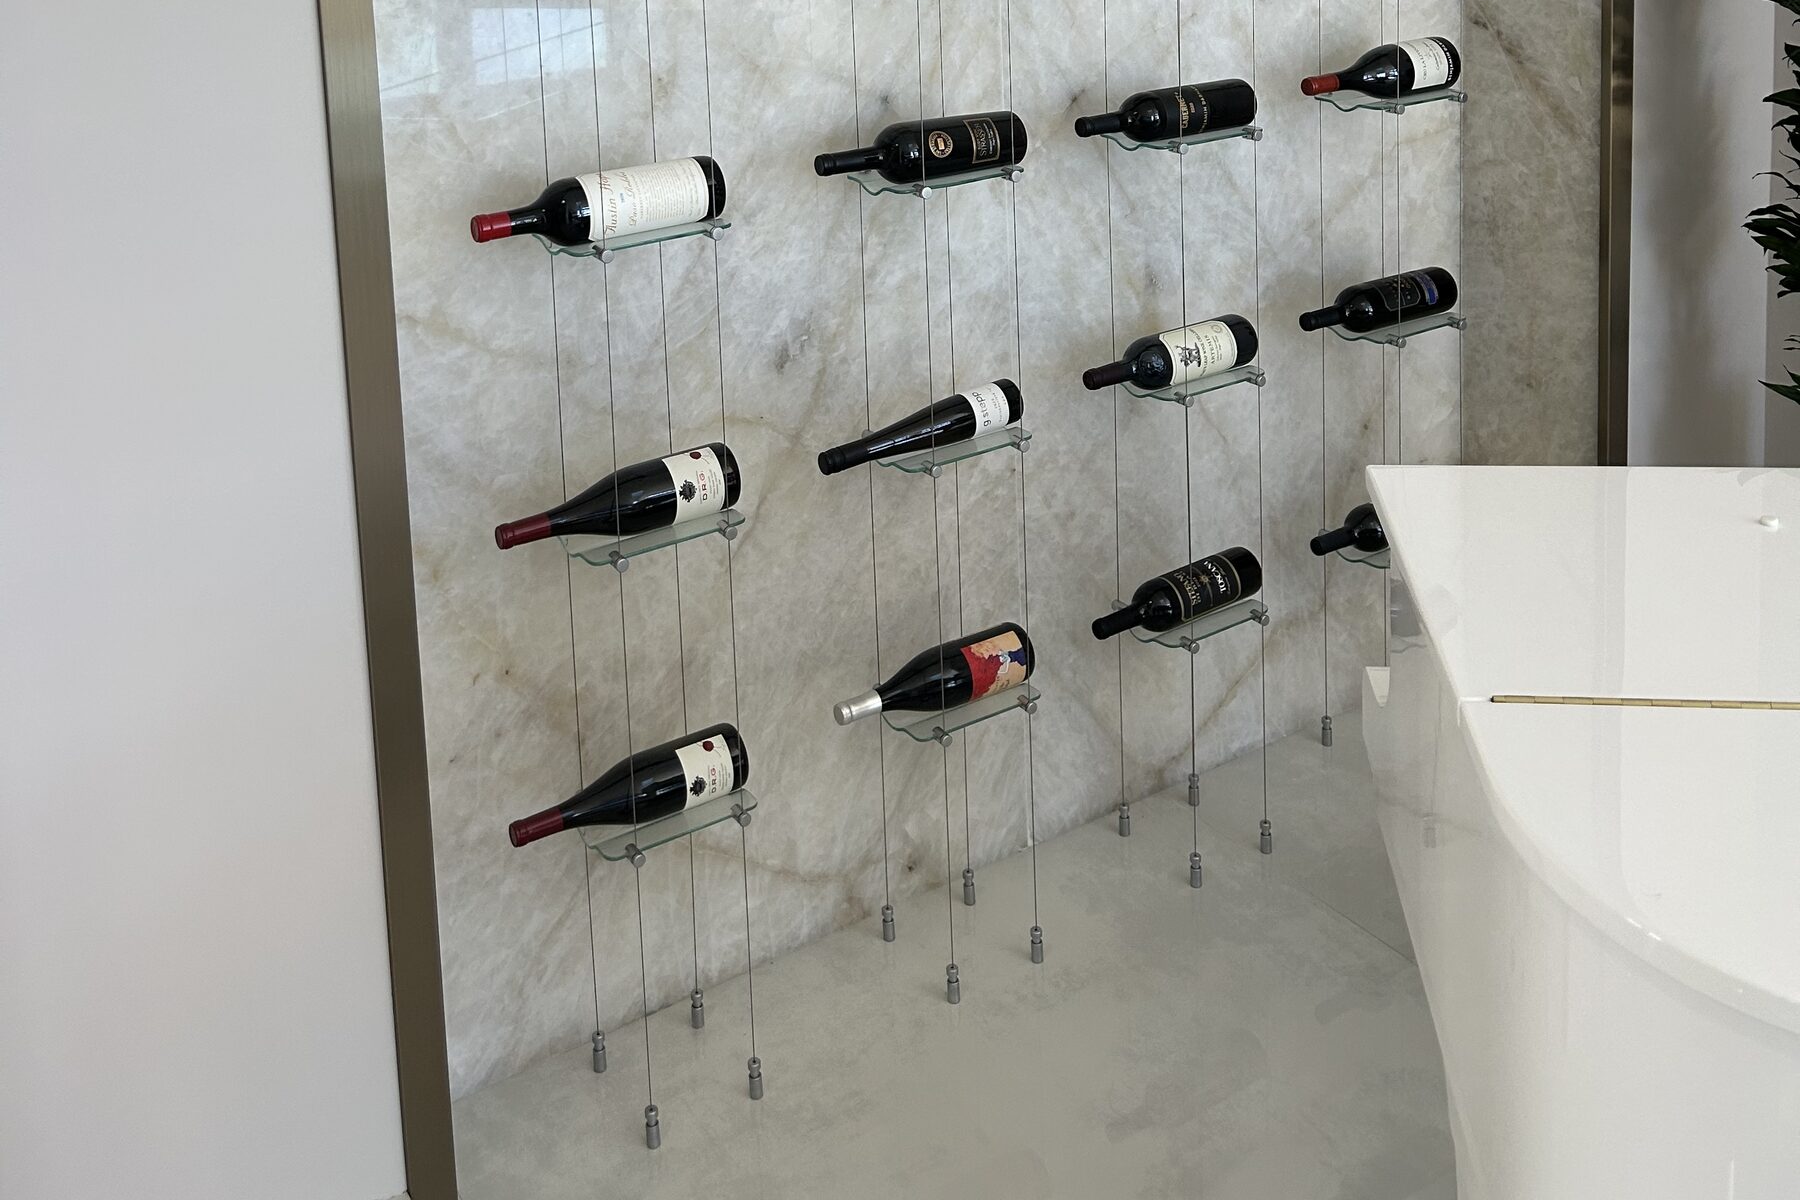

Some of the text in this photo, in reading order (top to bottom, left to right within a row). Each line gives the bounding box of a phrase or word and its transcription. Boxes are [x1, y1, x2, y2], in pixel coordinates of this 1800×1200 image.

[1175, 93, 1189, 129] CABERNET
[604, 198, 618, 233] Austin
[1205, 335, 1215, 364] ARTEMIS
